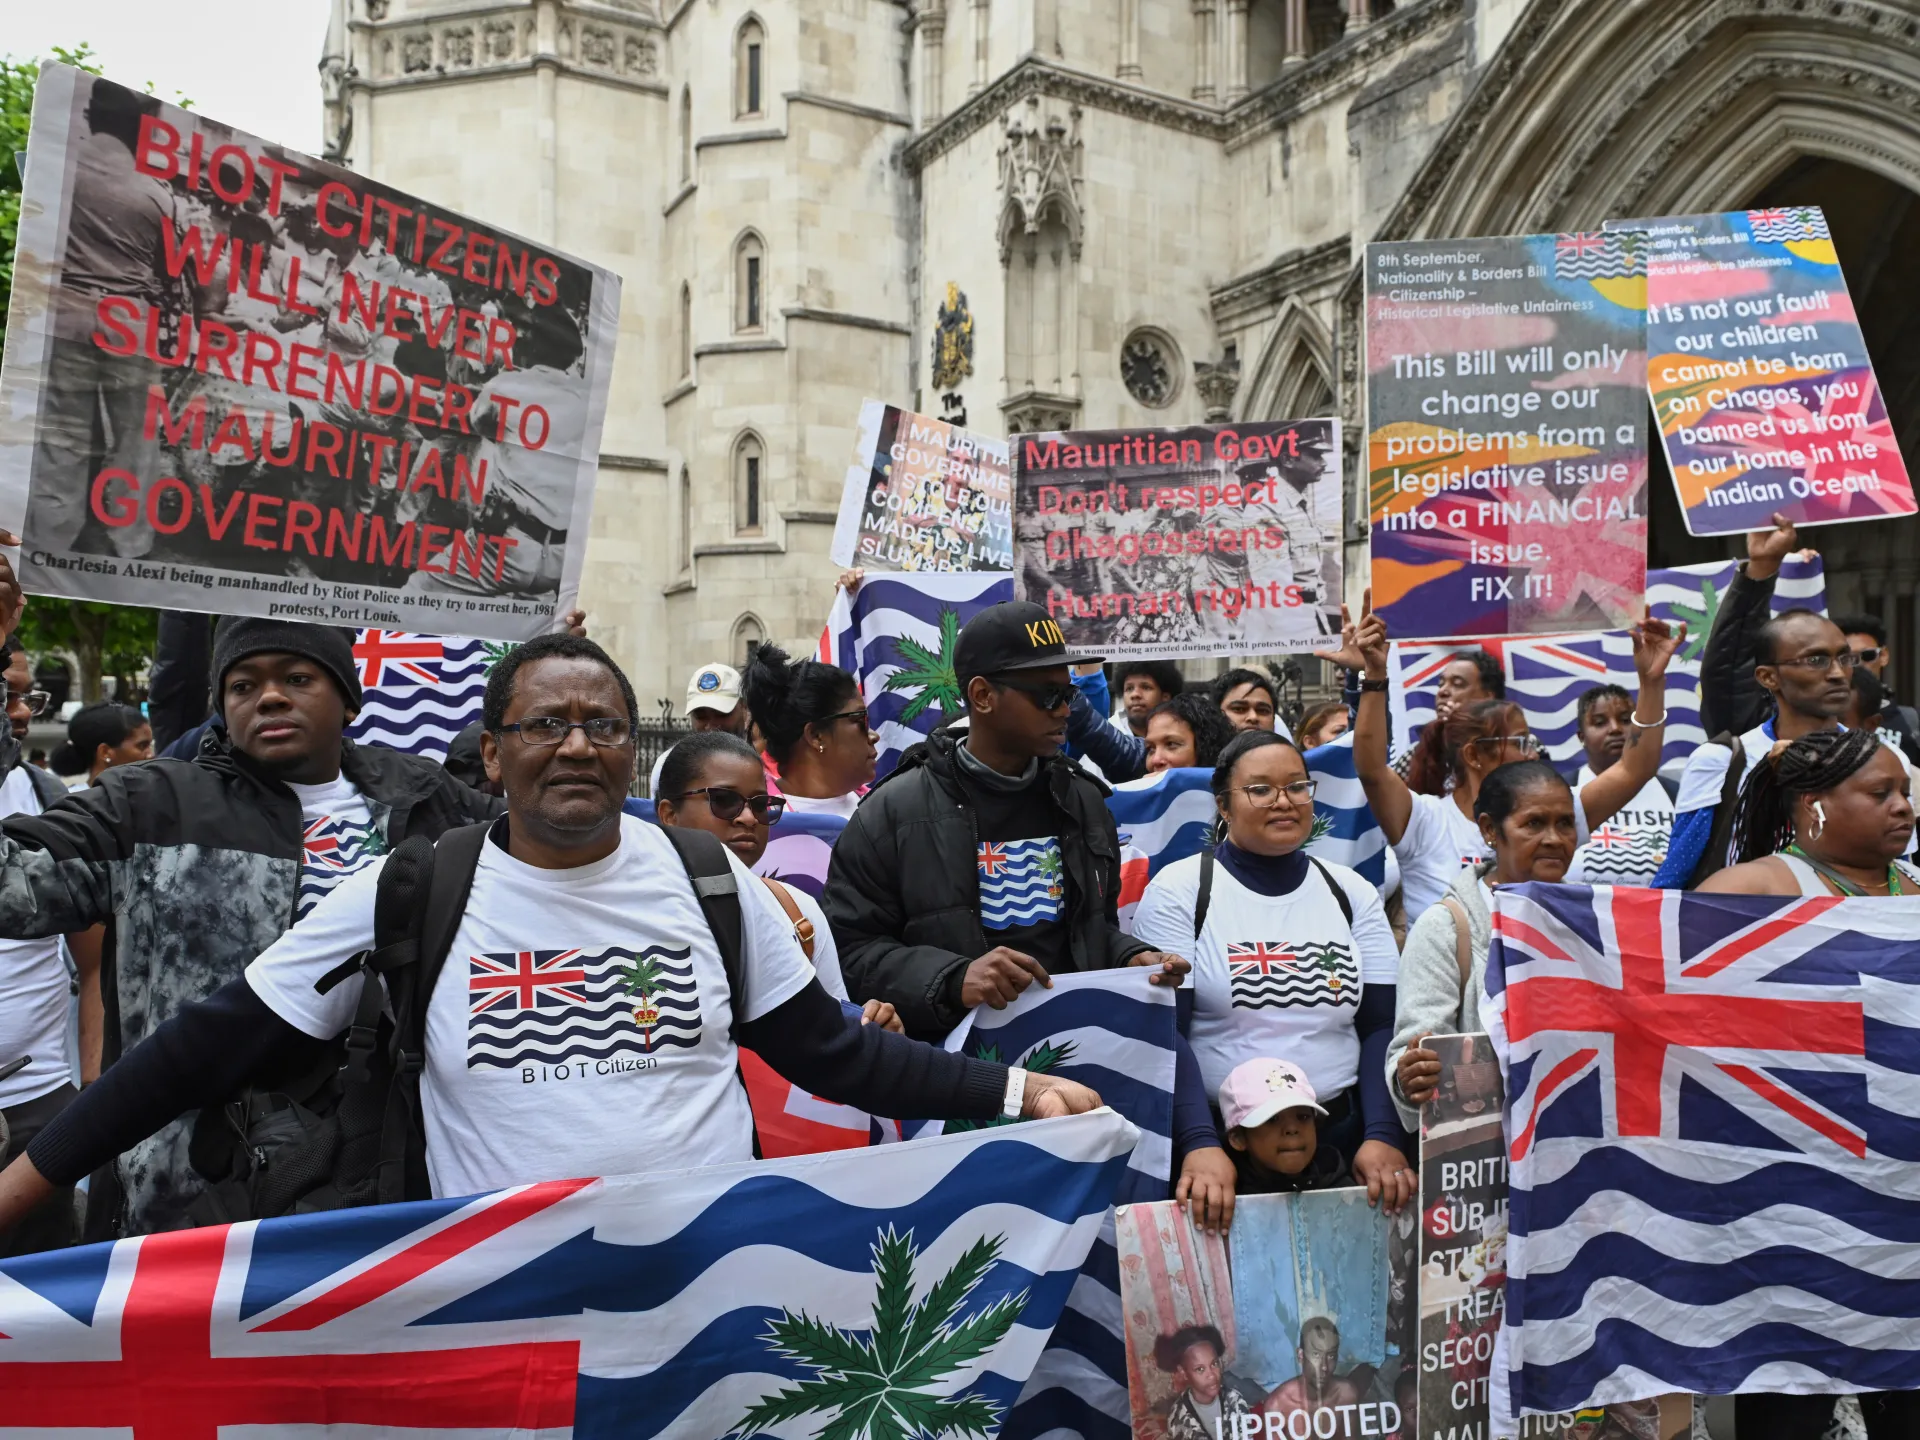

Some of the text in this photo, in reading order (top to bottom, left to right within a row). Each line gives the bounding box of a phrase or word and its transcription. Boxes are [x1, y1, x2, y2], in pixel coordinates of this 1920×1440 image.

[135, 114, 560, 304] BIOT CITIZENS
[1378, 252, 1485, 268] 8th September,
[1378, 265, 1547, 285] Nationality & Borders Bill
[161, 217, 516, 369] WILL NEVER
[1379, 299, 1594, 320] Historical Legislative Unfairness
[1389, 287, 1465, 303] Citizenship
[1664, 302, 1684, 323] is
[1691, 298, 1728, 320] not
[1735, 299, 1772, 317] our
[1777, 290, 1830, 313] fault
[1676, 323, 1819, 351] our children
[92, 297, 550, 450] SURRENDER TO
[1392, 343, 1628, 379] This Bill will only
[1662, 351, 1848, 383] cannot be born
[1421, 388, 1600, 419] change our
[1669, 380, 1859, 413] on Chagos, you
[143, 385, 488, 504] MAURITIAN
[1387, 423, 1635, 461] problems from a
[1678, 411, 1868, 445] banned us from
[1026, 428, 1299, 470] Mauritian Govt
[1689, 440, 1878, 475] our home in the
[903, 472, 971, 505] STOLE
[1038, 477, 1278, 516] Don't respect
[1393, 461, 1628, 497] legislative issue
[1704, 470, 1881, 507] Indian Ocean!
[91, 467, 518, 581] GOVERNMENT
[1382, 496, 1640, 531] into a FINANCIAL
[865, 512, 1012, 570] MADE US LIVE
[1046, 524, 1283, 565] Chagossians
[1471, 540, 1551, 564] issue.
[30, 551, 555, 615] Charlesia Alexi being manhandled by Riot Police as they try to arrest her, 1981
[1047, 579, 1303, 618] Human rights
[1471, 575, 1553, 601] FIX IT!
[269, 602, 401, 623] protests, Port Louis.
[1084, 646, 1115, 655] woman
[1118, 646, 1142, 655] being
[1145, 643, 1180, 653] arrested
[1182, 642, 1211, 652] during
[1213, 641, 1227, 650] the
[1230, 641, 1248, 649] 1981
[1605, 810, 1675, 827] ITISH
[595, 1056, 658, 1076] Citizen
[1442, 1156, 1509, 1191] BRITI
[1422, 1330, 1499, 1373] SECO
[1216, 1401, 1401, 1440] UPROOTED
